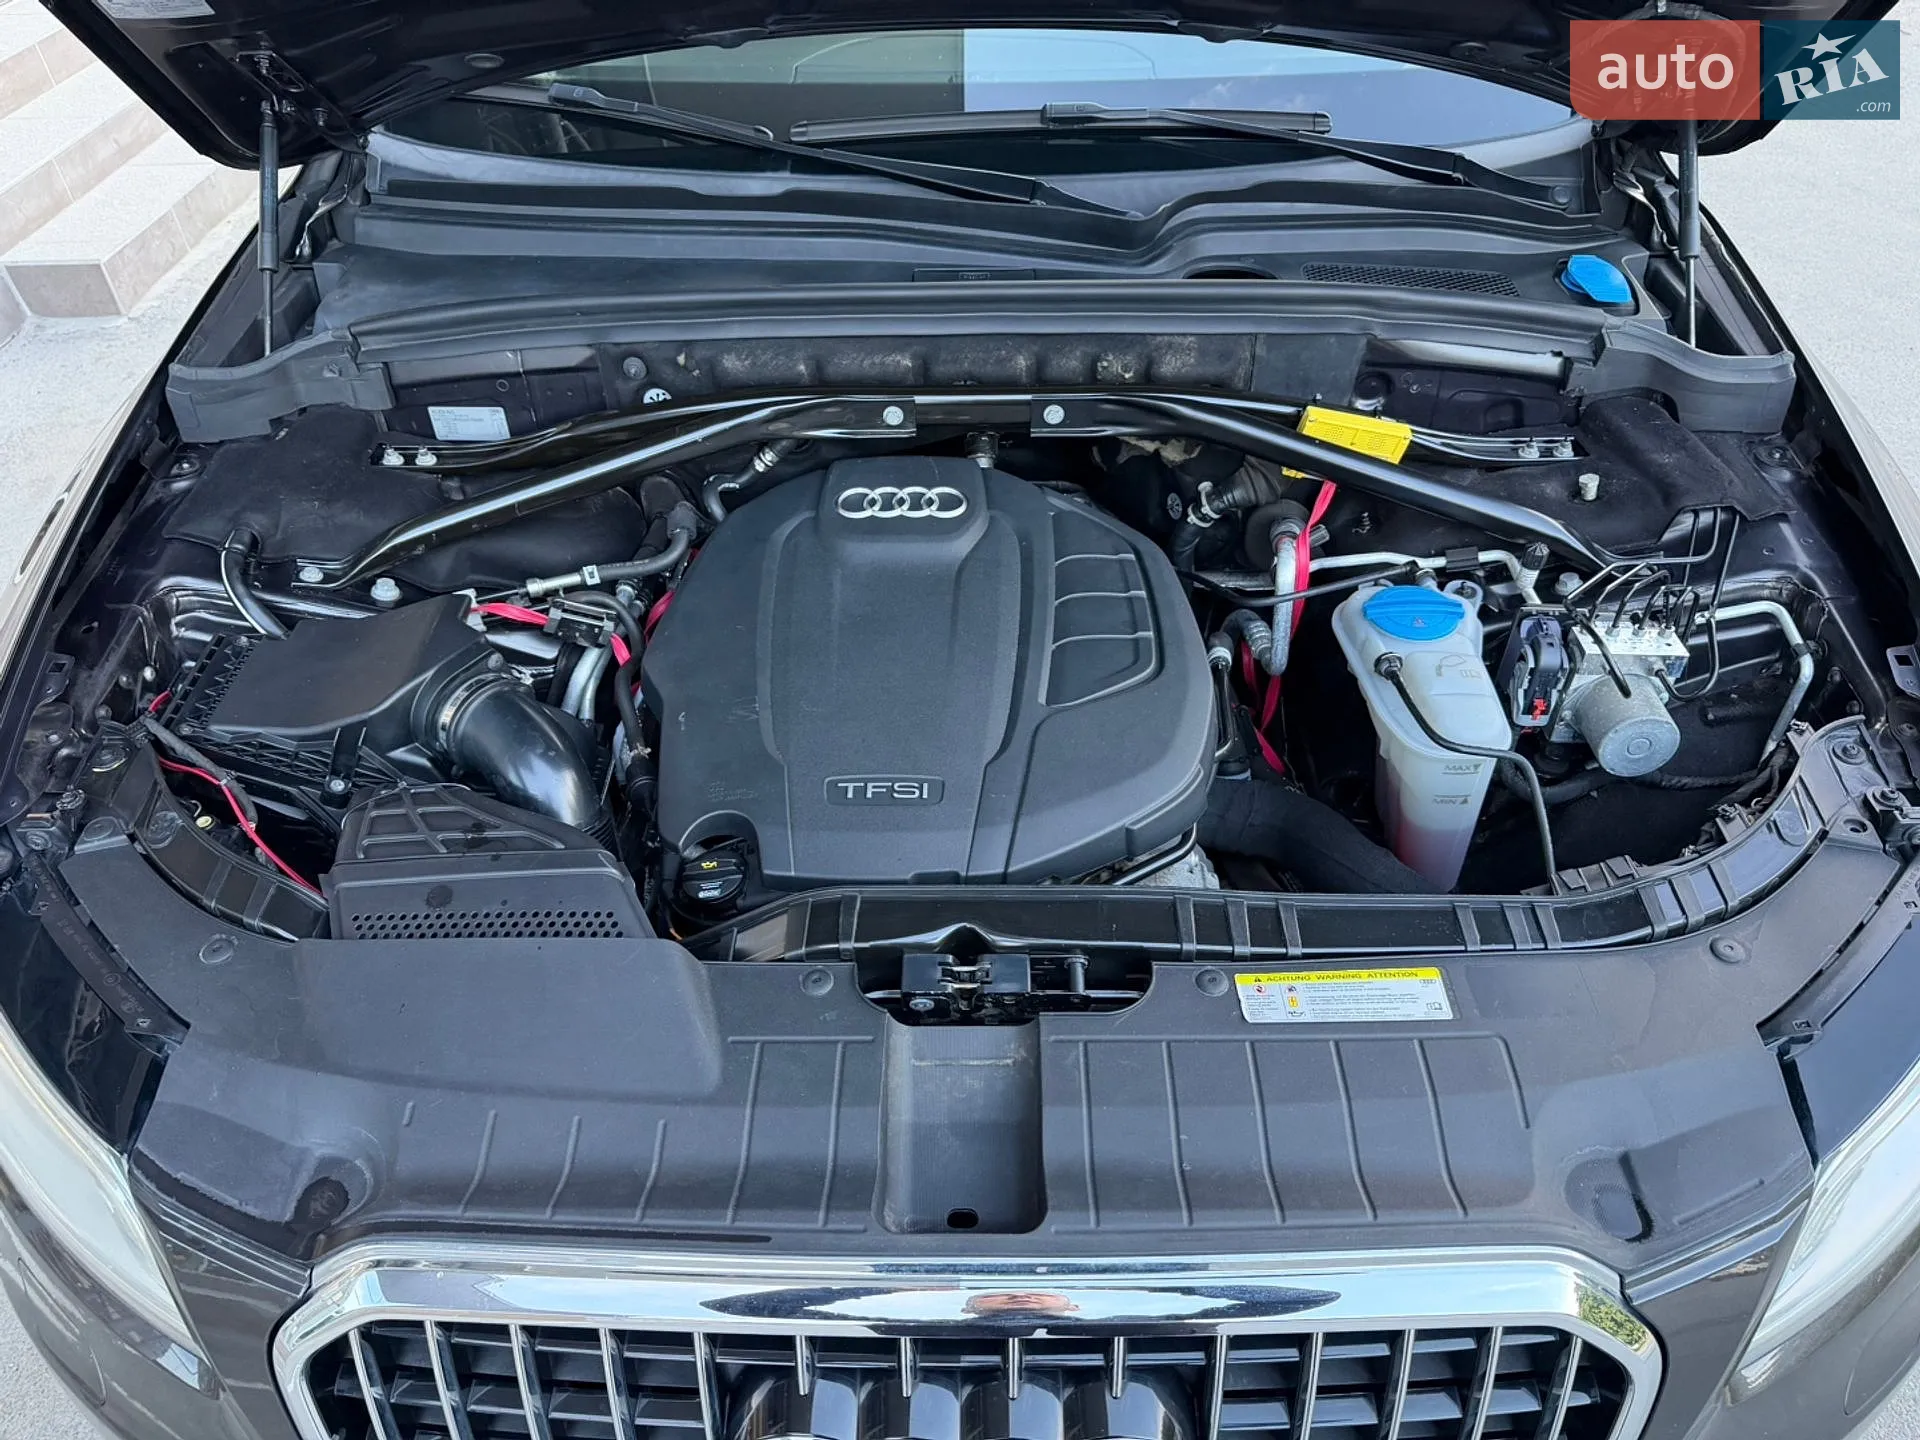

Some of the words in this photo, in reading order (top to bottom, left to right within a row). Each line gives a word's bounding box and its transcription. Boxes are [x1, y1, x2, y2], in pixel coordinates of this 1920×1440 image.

[1443, 763, 1471, 771] MAX
[837, 782, 929, 799] TFSI
[1266, 974, 1311, 982] ACHTUNG
[1367, 971, 1418, 979] ATTENTION
